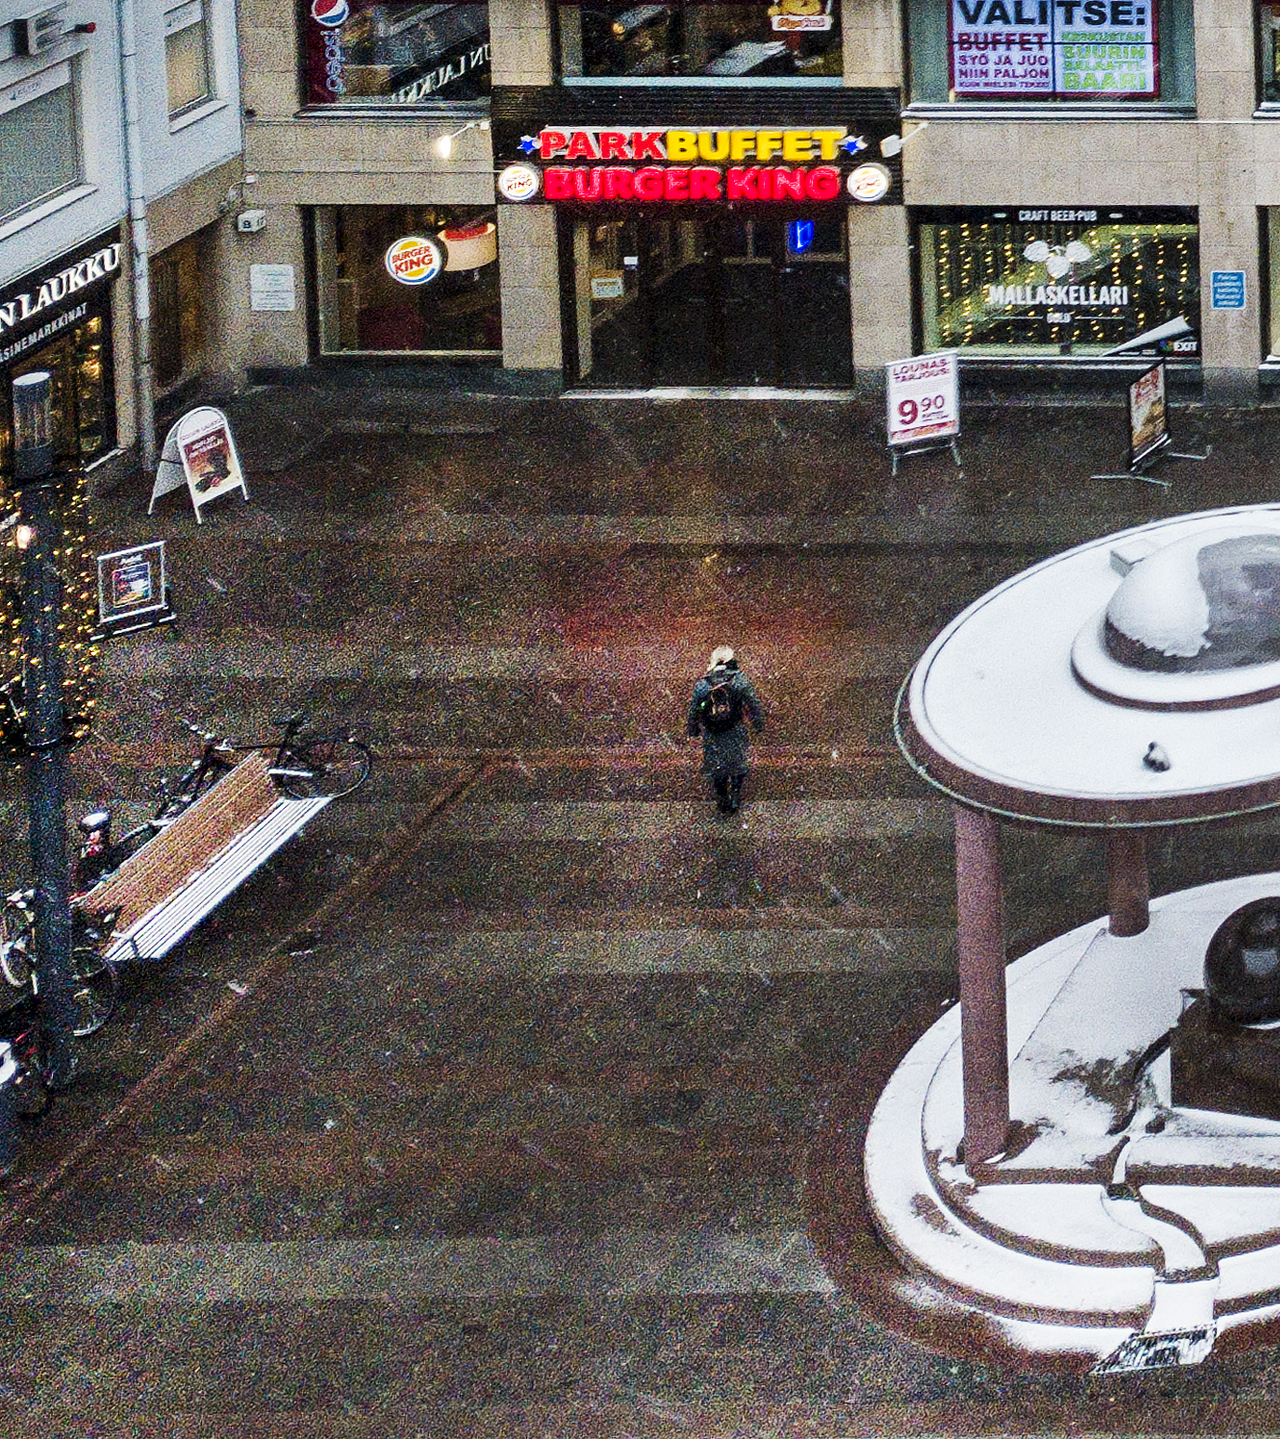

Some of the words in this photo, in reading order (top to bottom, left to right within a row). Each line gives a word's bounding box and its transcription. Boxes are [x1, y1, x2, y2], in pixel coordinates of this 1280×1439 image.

[957, 0, 1146, 26] VALITSE:
[959, 33, 1047, 51] BUFFET
[1063, 45, 1146, 58] SUURIN
[994, 55, 1013, 65] JA
[1018, 55, 1048, 65] JUO
[994, 68, 1049, 78] PALJON
[1064, 73, 1146, 89] BAARI
[538, 129, 847, 160] PARKBUFFET
[544, 165, 721, 201] BURGER
[727, 165, 842, 201] KING
[392, 246, 430, 263] BURGER
[394, 254, 433, 275] KING
[15, 243, 121, 320] LAUKKU
[989, 285, 1128, 305] MALLASKELLARI
